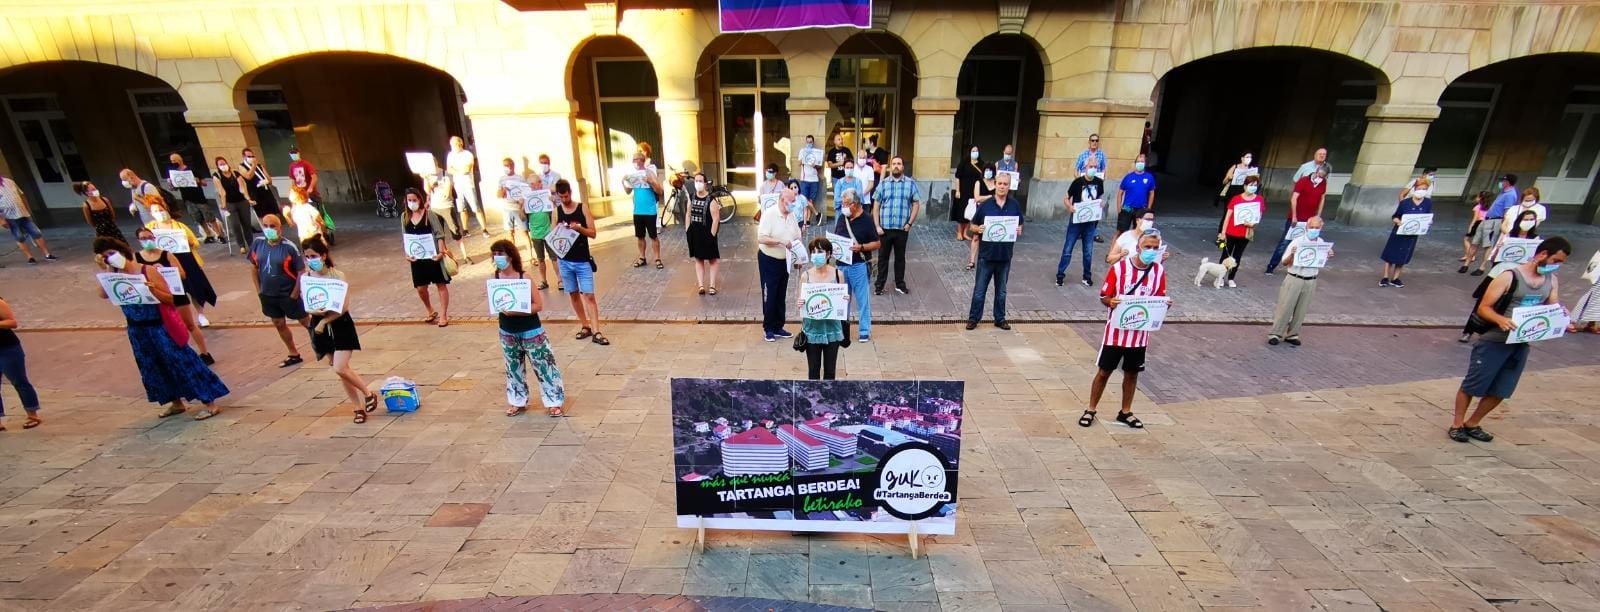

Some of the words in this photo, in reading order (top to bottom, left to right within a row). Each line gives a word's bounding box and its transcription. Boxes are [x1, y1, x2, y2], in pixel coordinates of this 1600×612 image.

[701, 475, 726, 488] más
[729, 475, 749, 486] que
[750, 471, 791, 484] nunca
[717, 485, 794, 502] TARTANGA
[798, 478, 860, 495] BERDEA!
[876, 490, 950, 500] #TartangaBerdea
[803, 493, 863, 513] betirako
